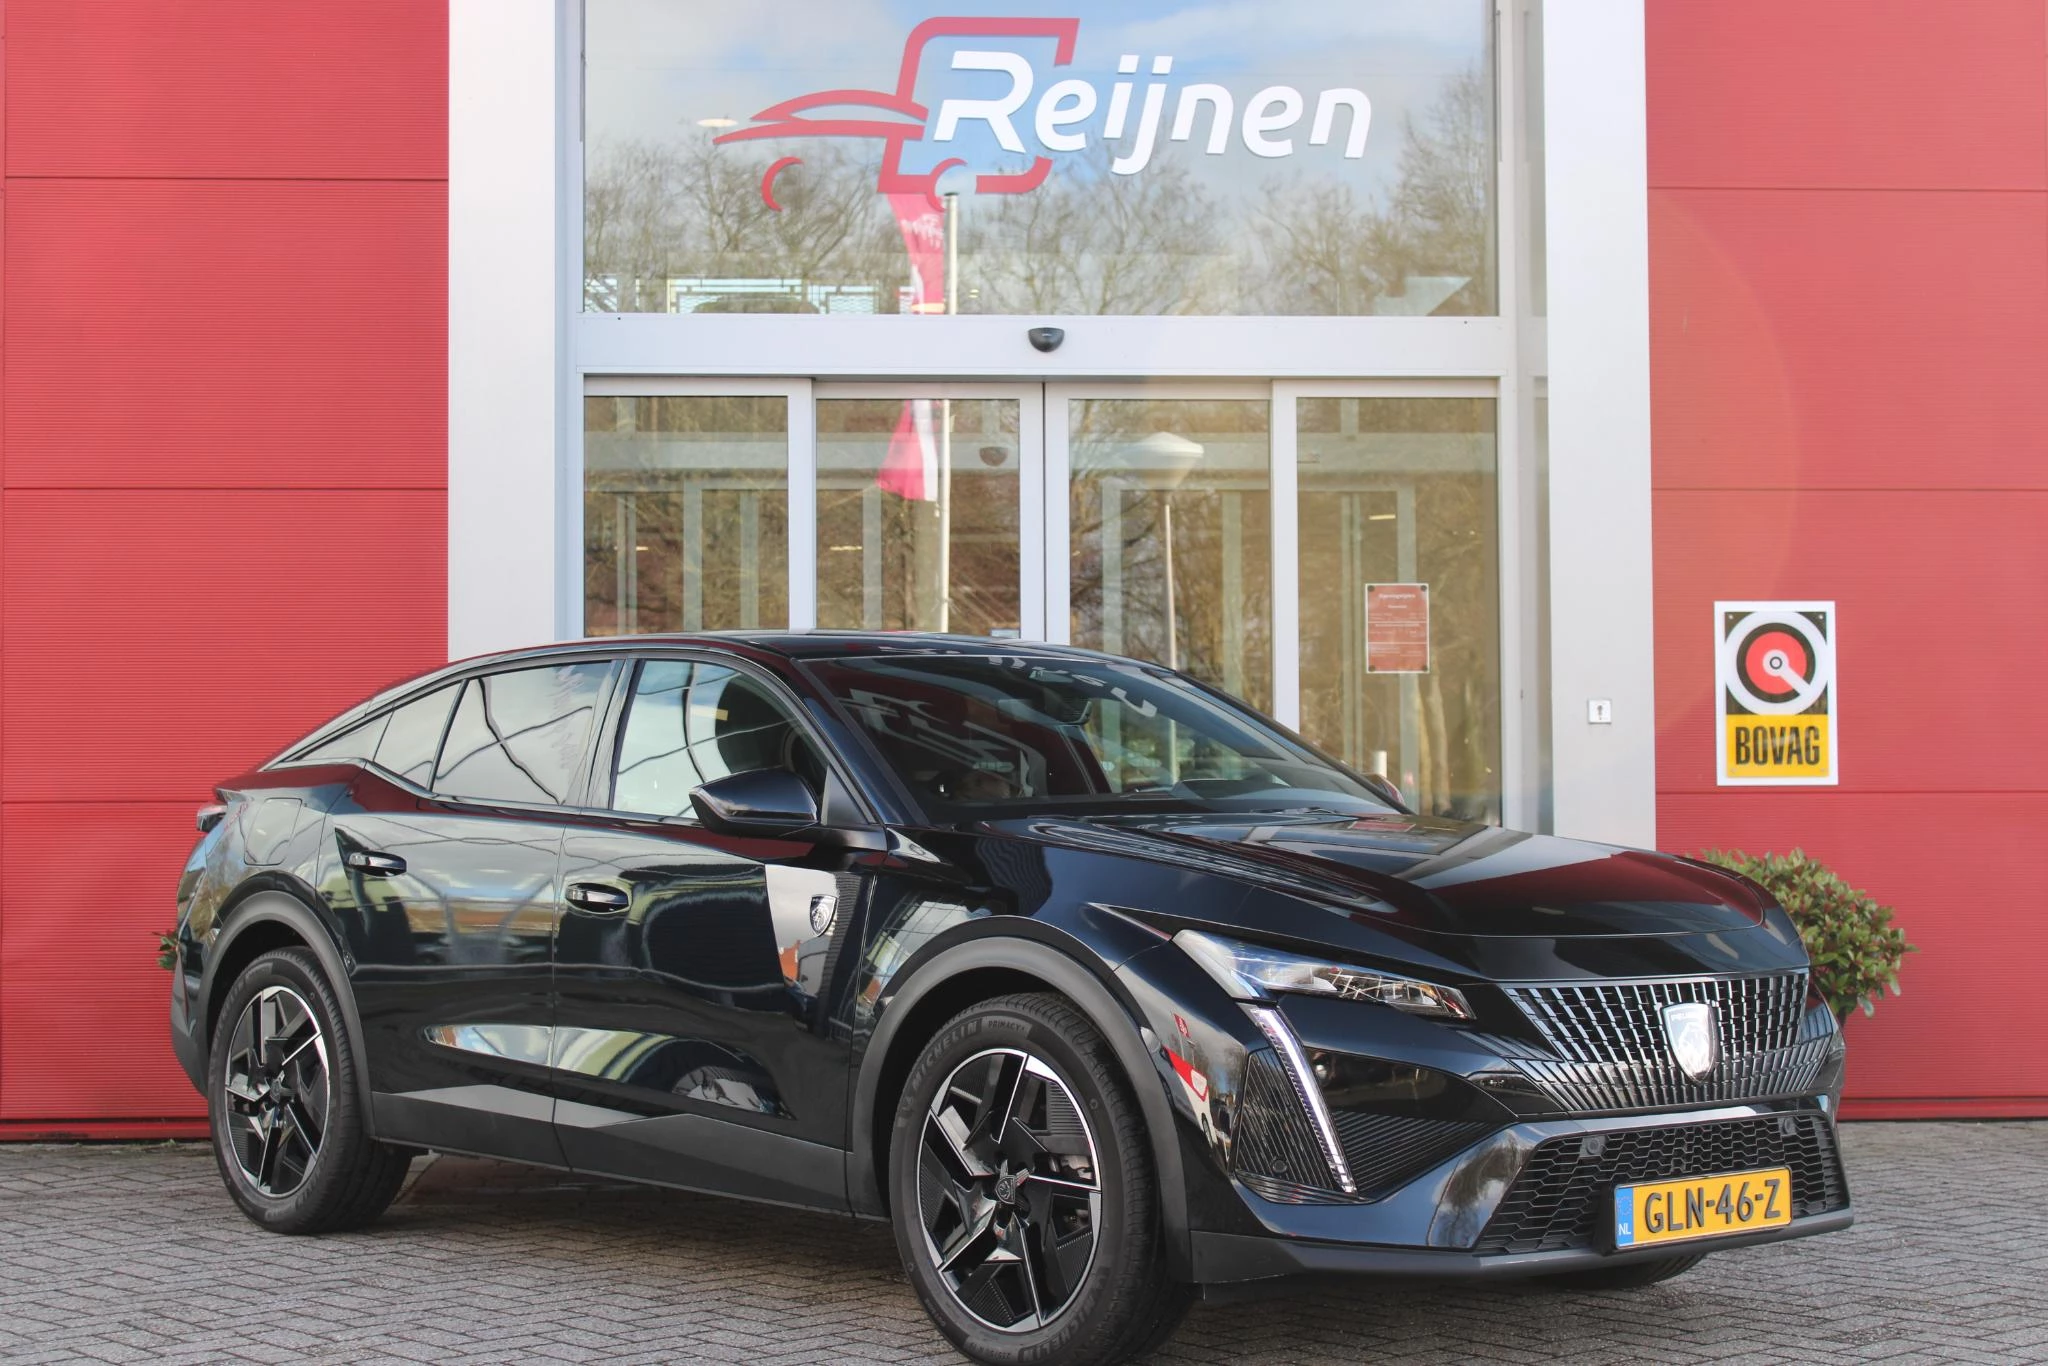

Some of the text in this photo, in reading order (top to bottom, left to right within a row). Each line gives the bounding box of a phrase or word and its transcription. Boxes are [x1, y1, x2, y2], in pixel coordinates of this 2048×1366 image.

[934, 50, 1372, 176] Reijnen
[1735, 725, 1820, 766] BOVAG
[1618, 1223, 1632, 1236] NL
[1645, 1178, 1782, 1234] GLN-46-Z
